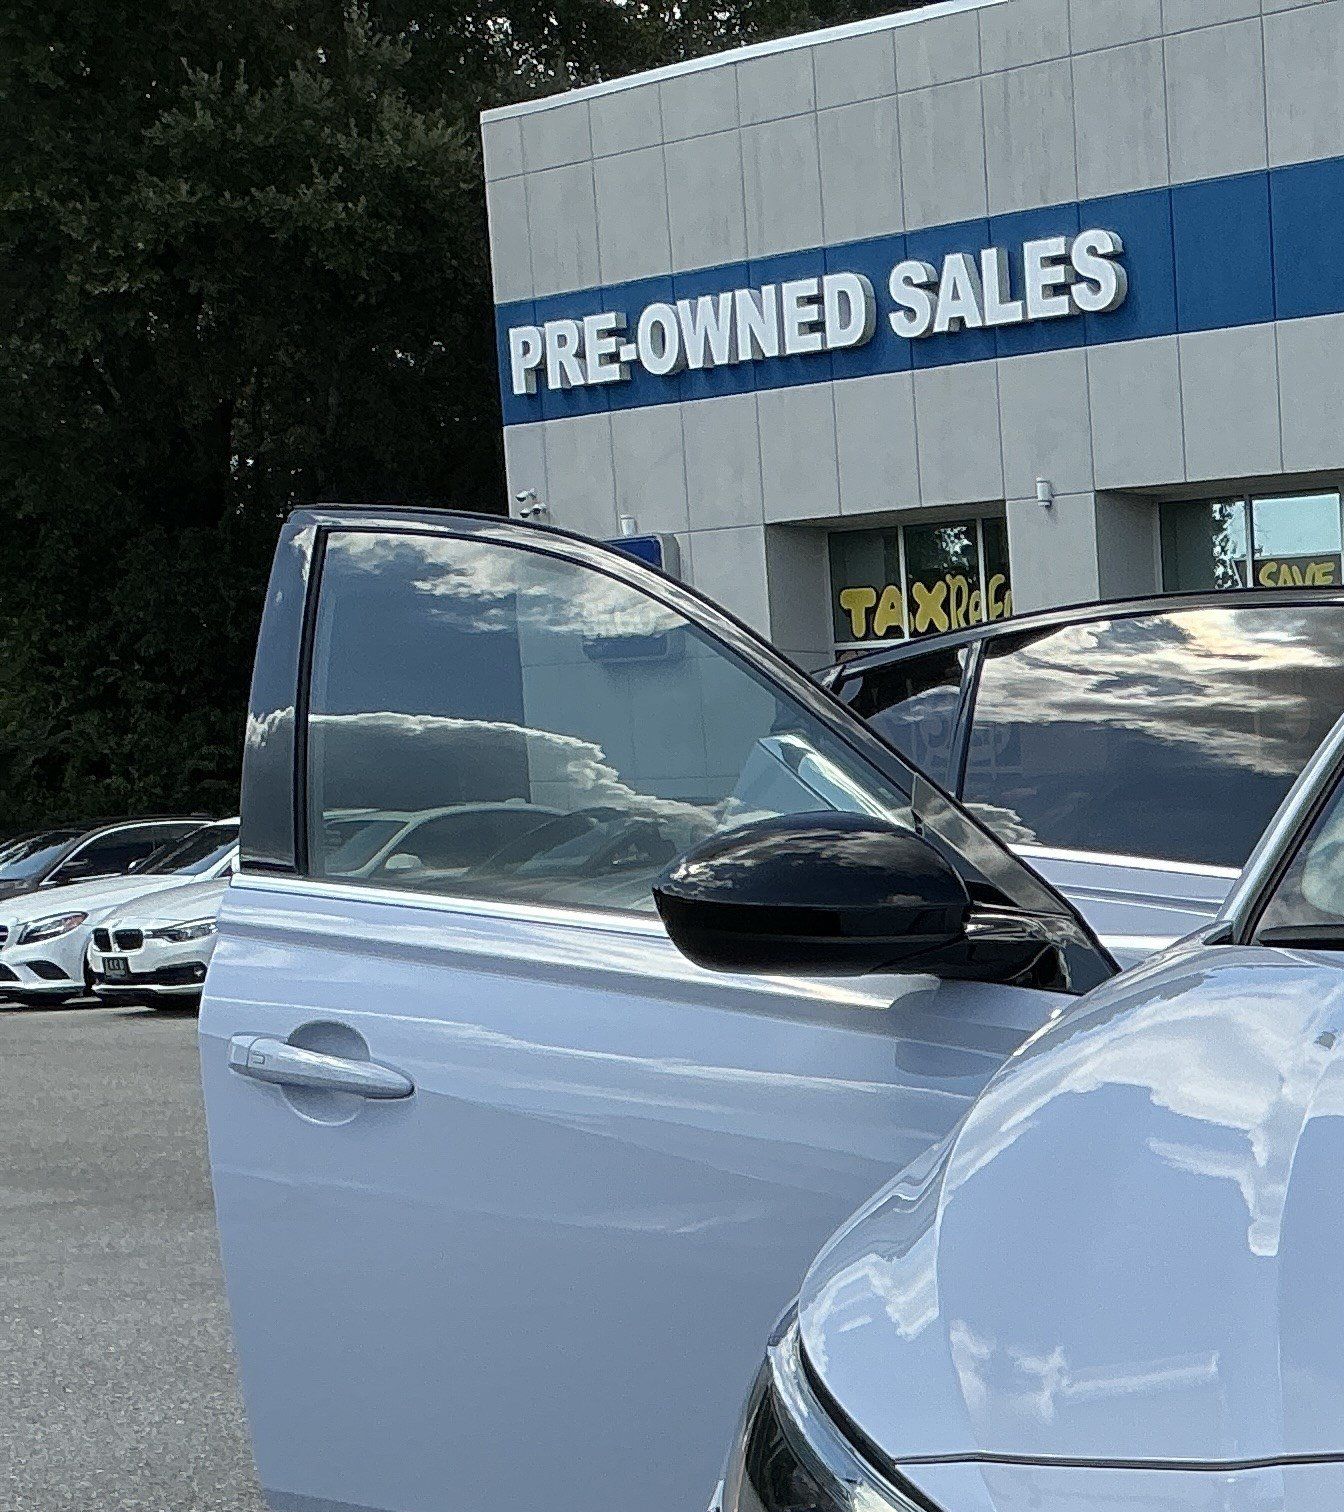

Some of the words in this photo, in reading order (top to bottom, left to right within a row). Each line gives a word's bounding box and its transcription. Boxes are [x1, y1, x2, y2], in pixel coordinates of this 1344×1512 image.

[509, 272, 873, 394] PRE-OWNED
[889, 230, 1126, 338] SALES
[1259, 562, 1336, 587] SAVE
[840, 584, 949, 638] TAX
